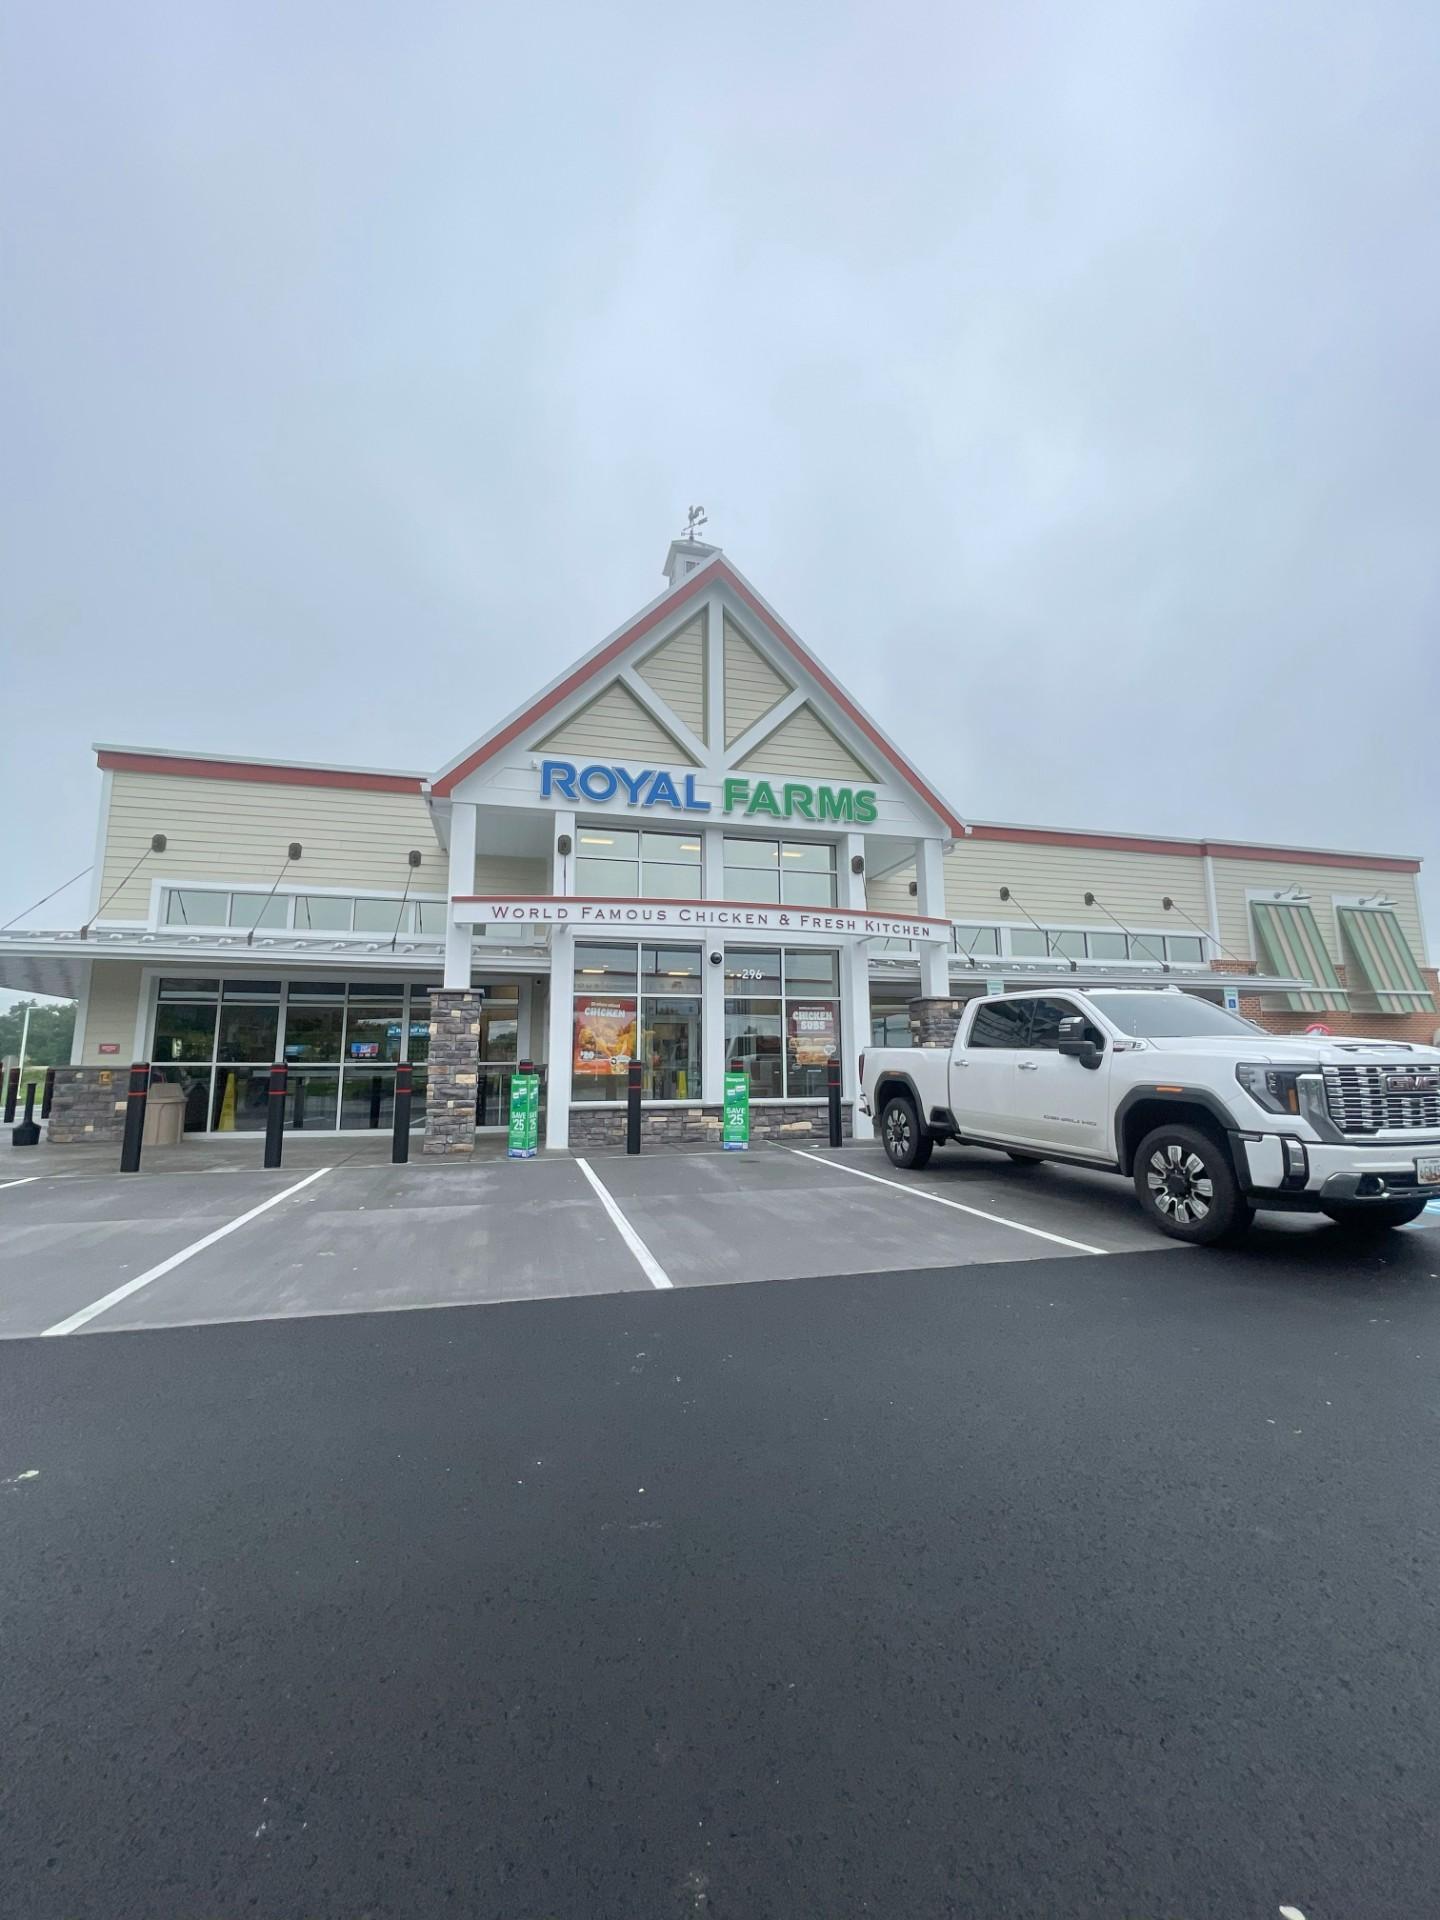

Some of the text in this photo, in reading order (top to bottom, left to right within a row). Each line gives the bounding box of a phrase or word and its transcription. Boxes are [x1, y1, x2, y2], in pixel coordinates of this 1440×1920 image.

[540, 760, 878, 824] ROYAL FARMS
[492, 906, 930, 937] WORLD FAMOUS CHICKEN & FRESH KITCHEN
[742, 968, 762, 980] 296
[584, 1007, 626, 1018] CHICKEN
[792, 1011, 833, 1021] CHICKEN
[800, 1021, 826, 1030] SUBS
[1386, 1076, 1440, 1091] GMC
[511, 1111, 527, 1119] SAVE
